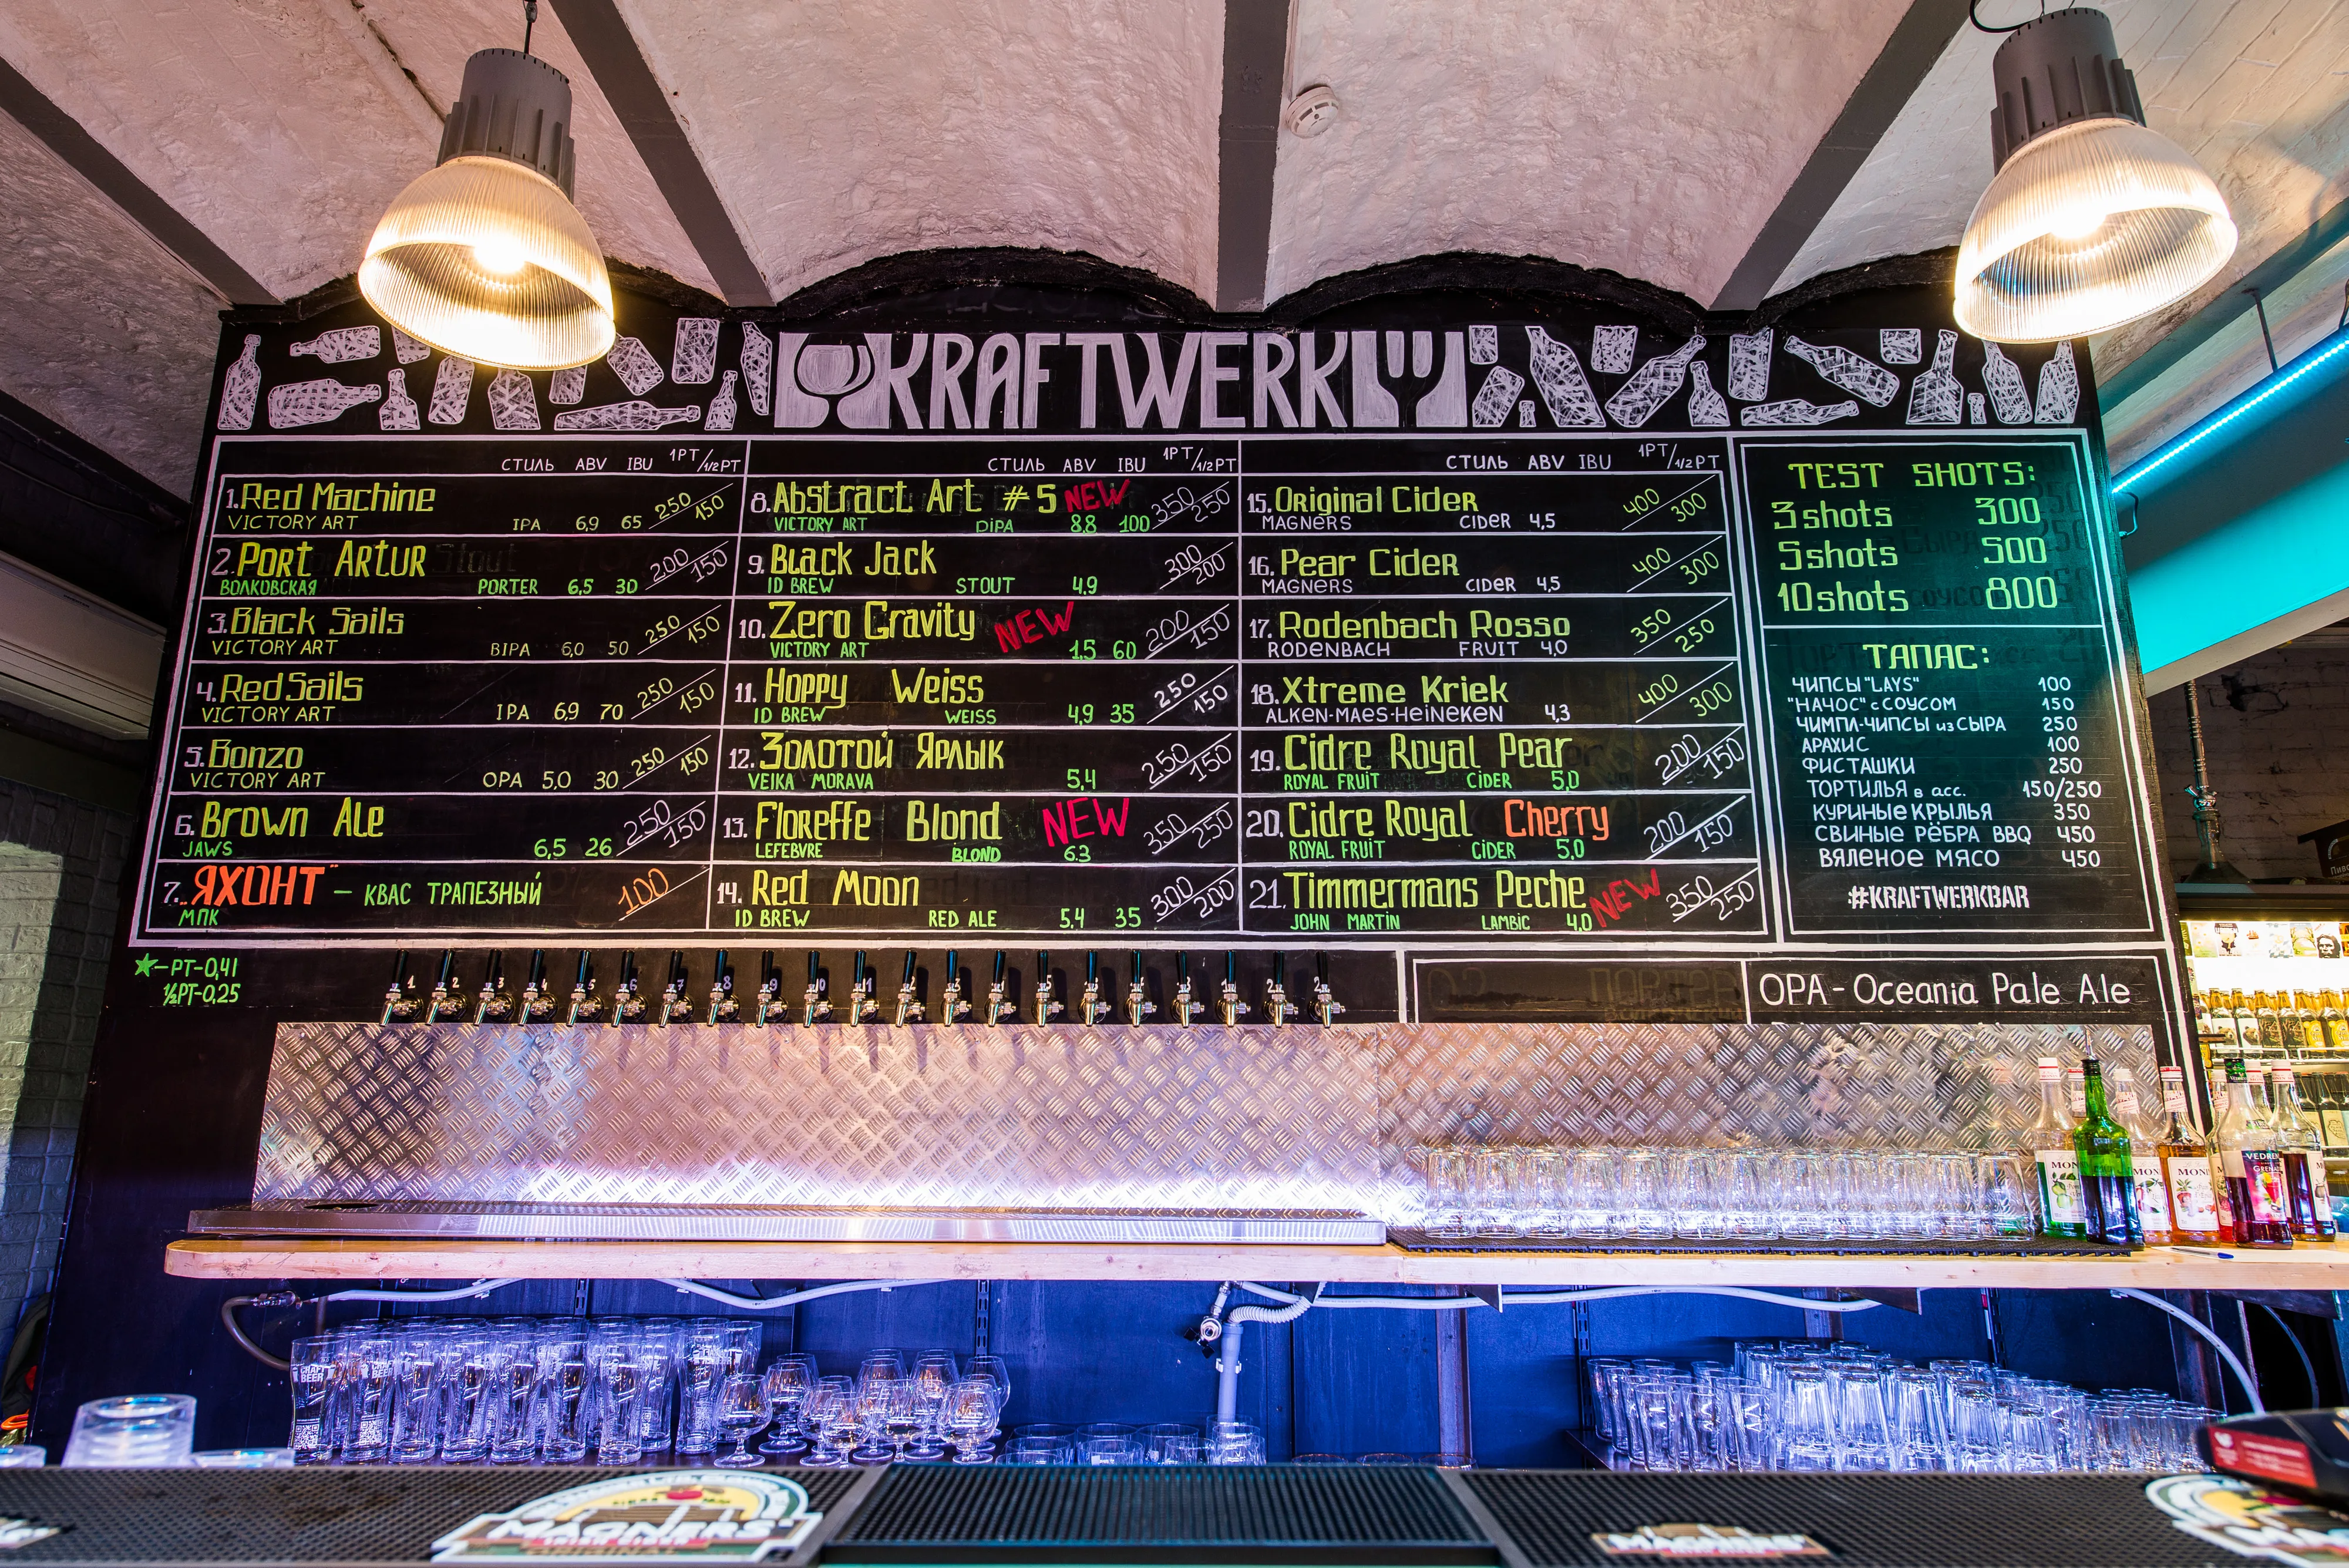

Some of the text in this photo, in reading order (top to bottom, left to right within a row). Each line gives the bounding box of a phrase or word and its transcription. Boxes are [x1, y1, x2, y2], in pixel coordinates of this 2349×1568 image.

[869, 331, 1348, 430] KRAFTWERK
[502, 457, 652, 471] СТИЛЬ ABV IBU
[988, 457, 1145, 472] СТИЛЬ ABV IBU
[1446, 455, 1611, 469] СТИЛЬ ABV IBU
[1788, 462, 2035, 489] TEST SHOTS:
[312, 482, 435, 512] Machine
[773, 479, 981, 513] Abstract Art
[1065, 479, 1129, 512] NEW
[228, 514, 641, 530] VICTORY ART IPA 65
[1975, 497, 2041, 524] 300
[775, 515, 1149, 533] VICTORY ART 100
[771, 540, 937, 576] Black Jack
[1981, 537, 2047, 563] 500
[1281, 549, 1355, 576] Pear
[220, 579, 637, 595] ВОЛКОВСКАЯ PORTER 30
[956, 577, 1015, 594] STOUT
[1985, 577, 2058, 610] 800
[231, 607, 403, 634] Black Sails
[769, 601, 974, 641] Zero Gravity
[995, 601, 1073, 652] NEW
[1280, 610, 1570, 638] Rodenbach Rosso
[213, 640, 628, 656] VICTORY ART BIPA 50
[770, 641, 1136, 660] VICTORY ART 60
[1459, 642, 1519, 657] FRUIT
[1863, 644, 1989, 669] ТАПАС:
[286, 671, 363, 701] Sails
[765, 667, 984, 709] Hoppy Weiss
[1283, 675, 1509, 704] Xtreme Kriek
[1792, 677, 1861, 692] ЧИПСЫ
[2038, 677, 2071, 691] 100
[202, 704, 622, 722] VICTORY ART IPA 70
[945, 704, 1134, 724] WEISS 35
[2042, 697, 2074, 711] 150
[2042, 716, 2077, 732] 250
[208, 739, 303, 769] Bonzo
[760, 731, 893, 769] Золотой
[1285, 733, 1572, 775] Cidre Royal Pear
[1802, 736, 2079, 753] АРАХИС 100
[1802, 757, 2082, 775] ФИСТАШКИ 250
[191, 772, 522, 789] VICTORY ART OPA
[811, 773, 873, 789] MORAVA
[1284, 774, 1328, 790] ROYAL
[1806, 780, 1907, 798] ТОРТИЛЬЯ
[2022, 778, 2101, 802] 150/250
[201, 797, 383, 837] Brown Ale
[907, 800, 1002, 842] Blond
[1042, 798, 1129, 847] NEW
[1289, 799, 1609, 841] Cidre Royal Cherry
[1911, 803, 1993, 820] КРЫЛЬЯ
[2053, 803, 2090, 820] 350
[1993, 826, 2031, 844] BBQ
[2057, 825, 2095, 843] 450
[183, 838, 611, 857] JAWS 26
[756, 843, 1001, 862] LEFEBVRE BLOND
[1290, 840, 1334, 860] ROYAL
[1936, 849, 2000, 867] МЯСО
[2062, 850, 2101, 868] 450
[365, 872, 541, 906] КВАС ТРАПЕЗНЫЙ
[618, 867, 668, 915] 100
[752, 867, 919, 906] Red Moon
[1283, 869, 1586, 909] Timmermans Peche
[1589, 868, 1660, 927] NEW
[1848, 885, 2030, 909] #KRAFTWERKBAR
[179, 909, 218, 926] МПК
[929, 910, 997, 927] RED ALE
[1290, 913, 1330, 930] JOHN
[1854, 974, 1979, 1005] Oceania
[1992, 972, 2060, 1004] Pale
[2079, 974, 2130, 1005] Ale
[2246, 1152, 2280, 1160] VEDREN
[300, 1365, 325, 1374] CRAFT
[301, 1373, 324, 1383] BEER
